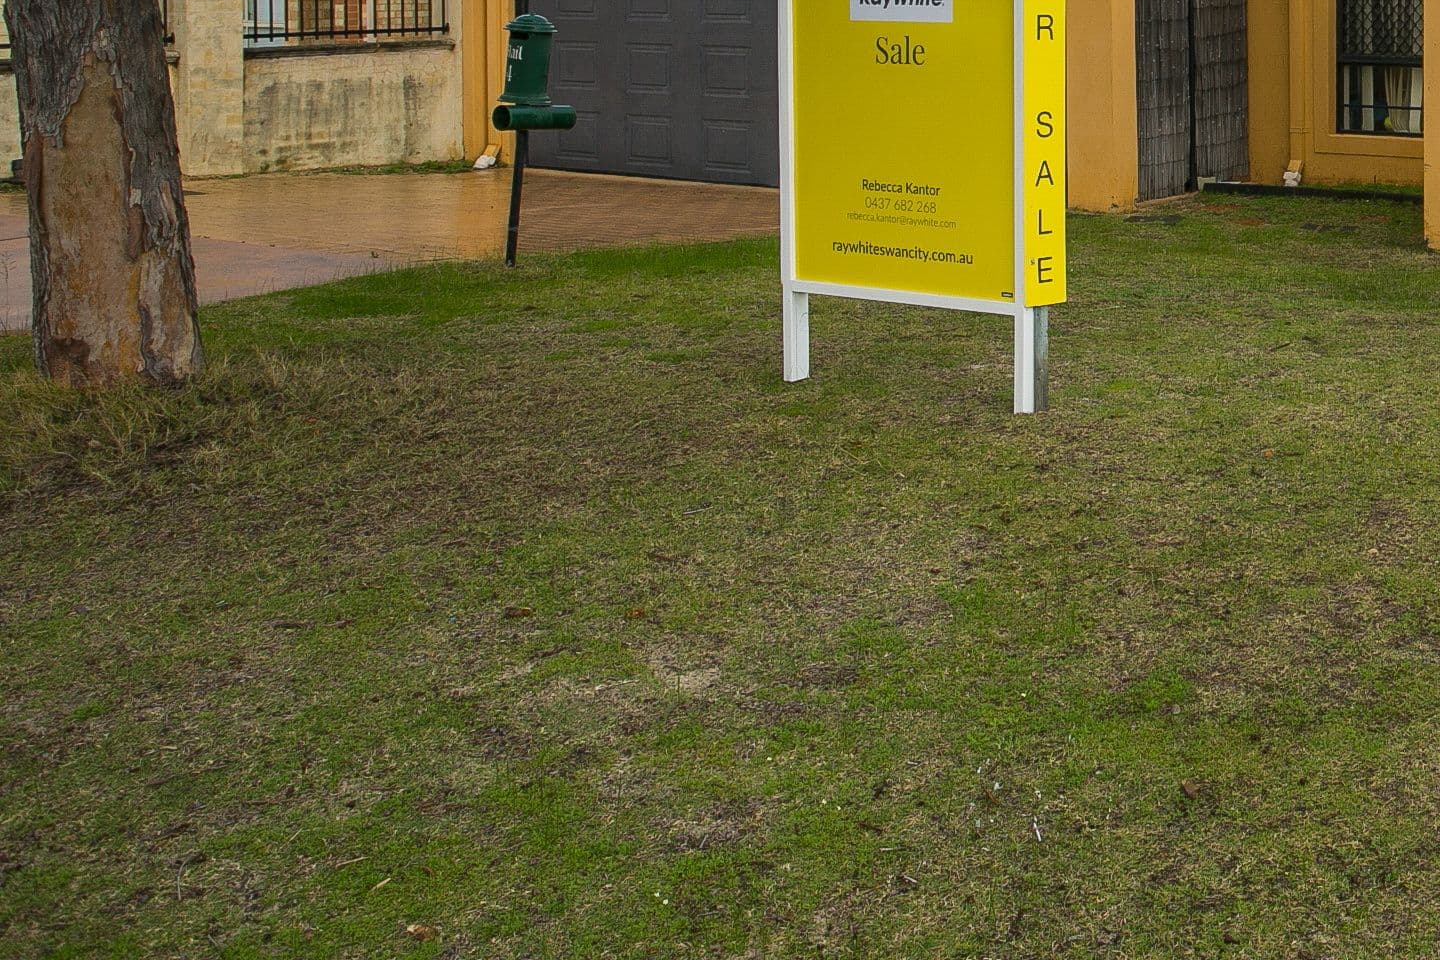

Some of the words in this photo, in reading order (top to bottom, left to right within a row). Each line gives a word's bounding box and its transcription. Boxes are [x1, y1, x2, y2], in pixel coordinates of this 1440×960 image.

[874, 35, 926, 66] Sale
[862, 178, 903, 194] Rebecca
[905, 182, 941, 196] Kantor
[1034, 110, 1055, 285] SALE
[864, 196, 891, 210] 0437
[894, 199, 913, 212] 682
[916, 201, 937, 214] 268
[832, 240, 974, 265] raywhiteswancity.com.au
